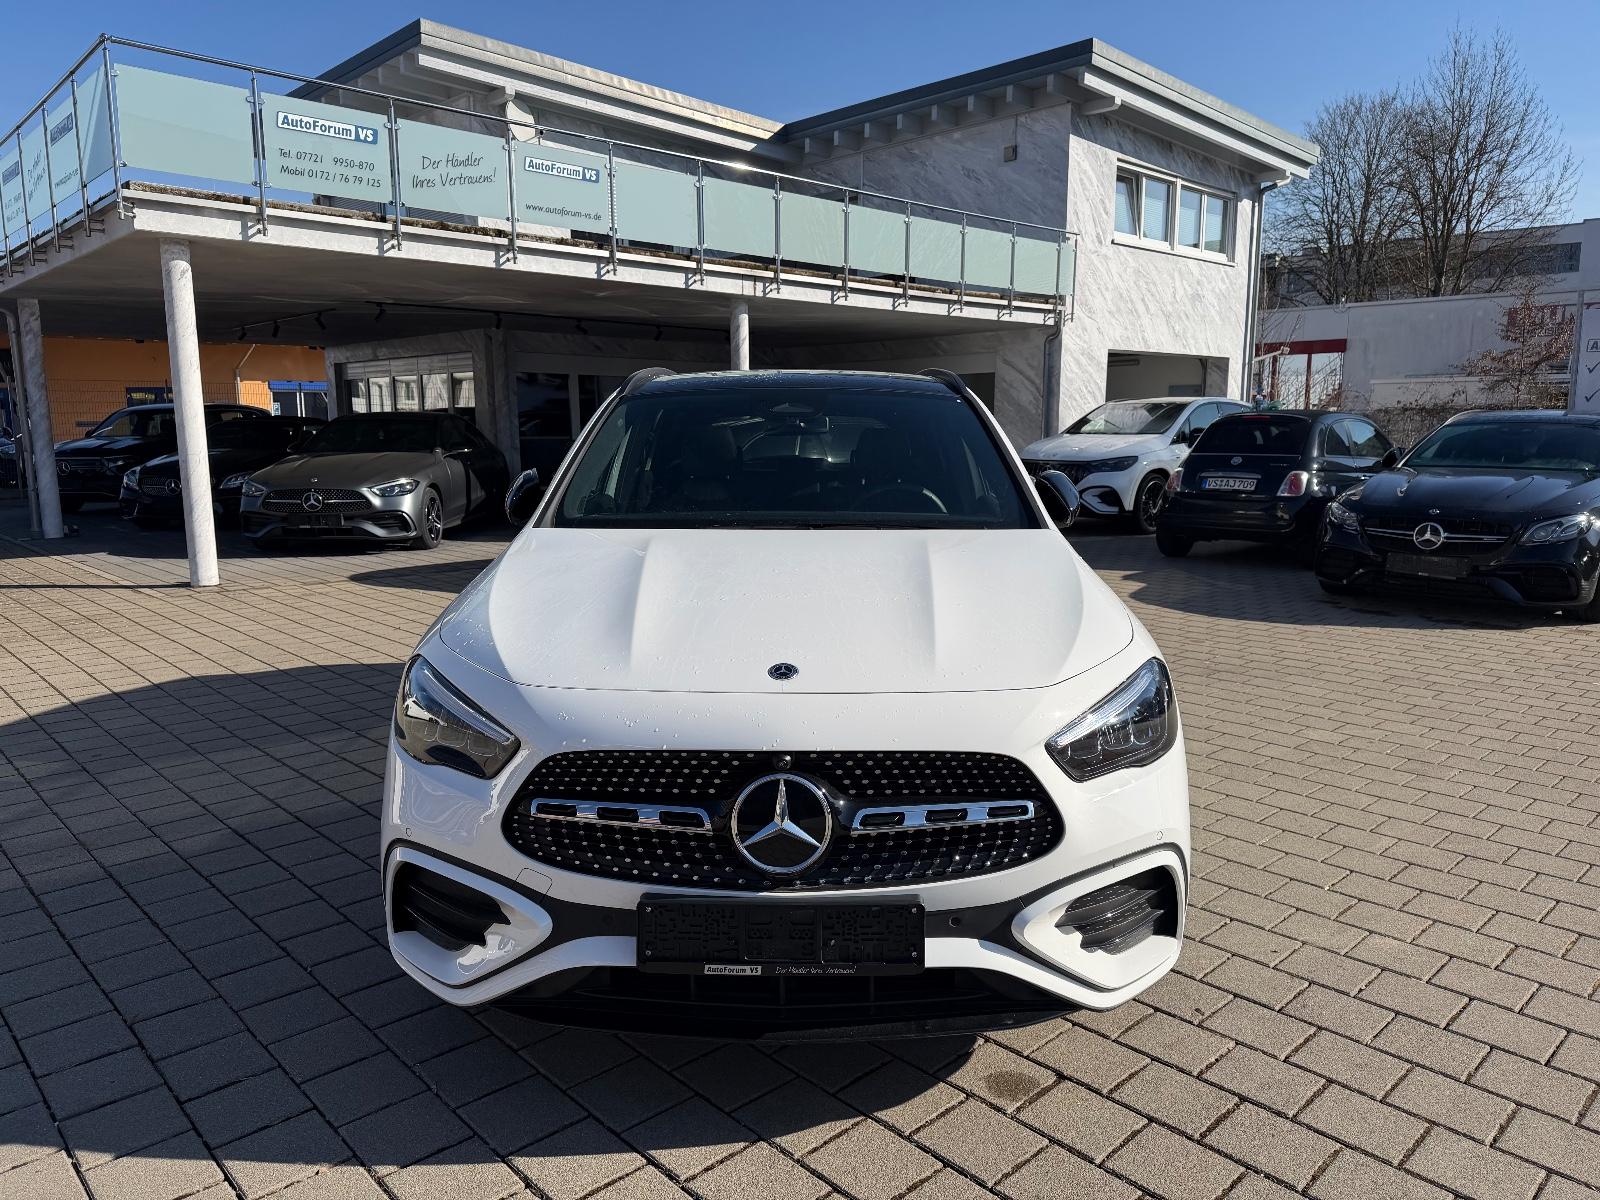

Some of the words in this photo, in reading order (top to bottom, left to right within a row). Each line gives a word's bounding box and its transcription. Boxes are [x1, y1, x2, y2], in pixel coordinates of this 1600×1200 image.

[281, 114, 353, 138] AutoForum
[357, 127, 374, 142] VS
[279, 148, 293, 159] Tel.
[296, 151, 323, 164] 07721
[333, 156, 375, 171] 9950-870
[422, 155, 442, 170] Der
[447, 151, 484, 167] Händler
[527, 159, 581, 178] AutoForum
[584, 168, 598, 181] VS
[280, 164, 305, 177] Mobil
[367, 177, 381, 188] 125
[412, 174, 436, 189] Ihres
[440, 167, 497, 188] Vertrauens!
[525, 203, 602, 221] www.autoforum-vs.de
[706, 966, 747, 974] AutoForum
[750, 966, 759, 974] VS
